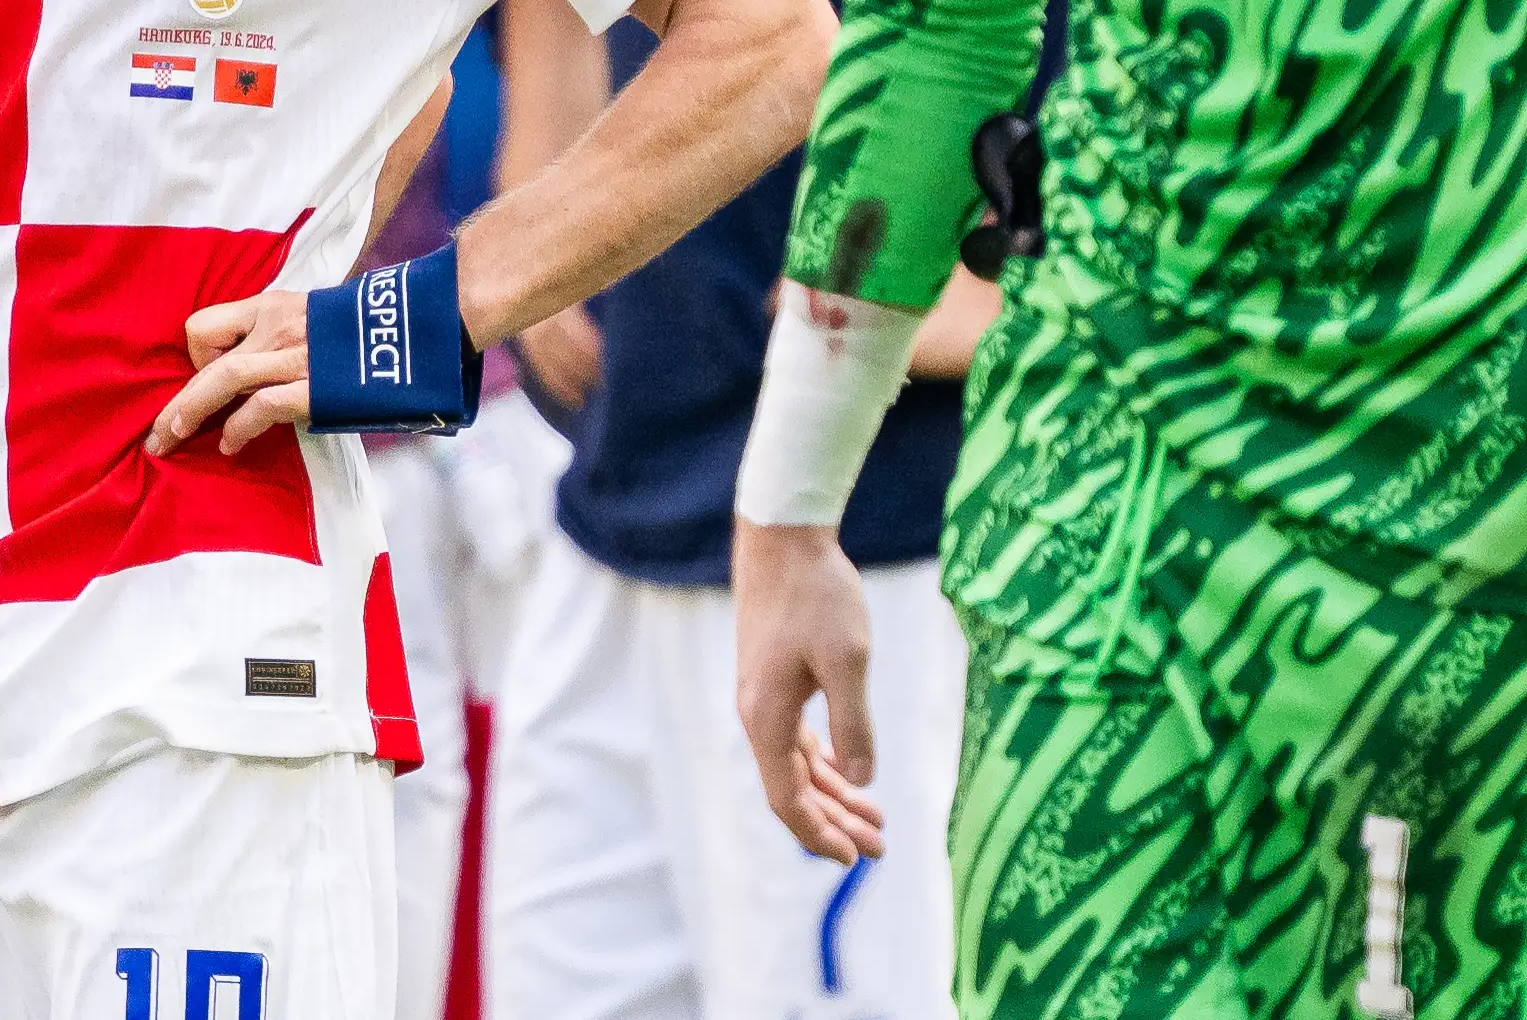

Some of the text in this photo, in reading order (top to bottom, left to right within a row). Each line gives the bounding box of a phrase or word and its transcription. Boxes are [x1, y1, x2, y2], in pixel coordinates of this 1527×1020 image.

[139, 27, 216, 48] HAMBURG,
[368, 268, 400, 384] RESPECT
[1358, 814, 1415, 1020] 1
